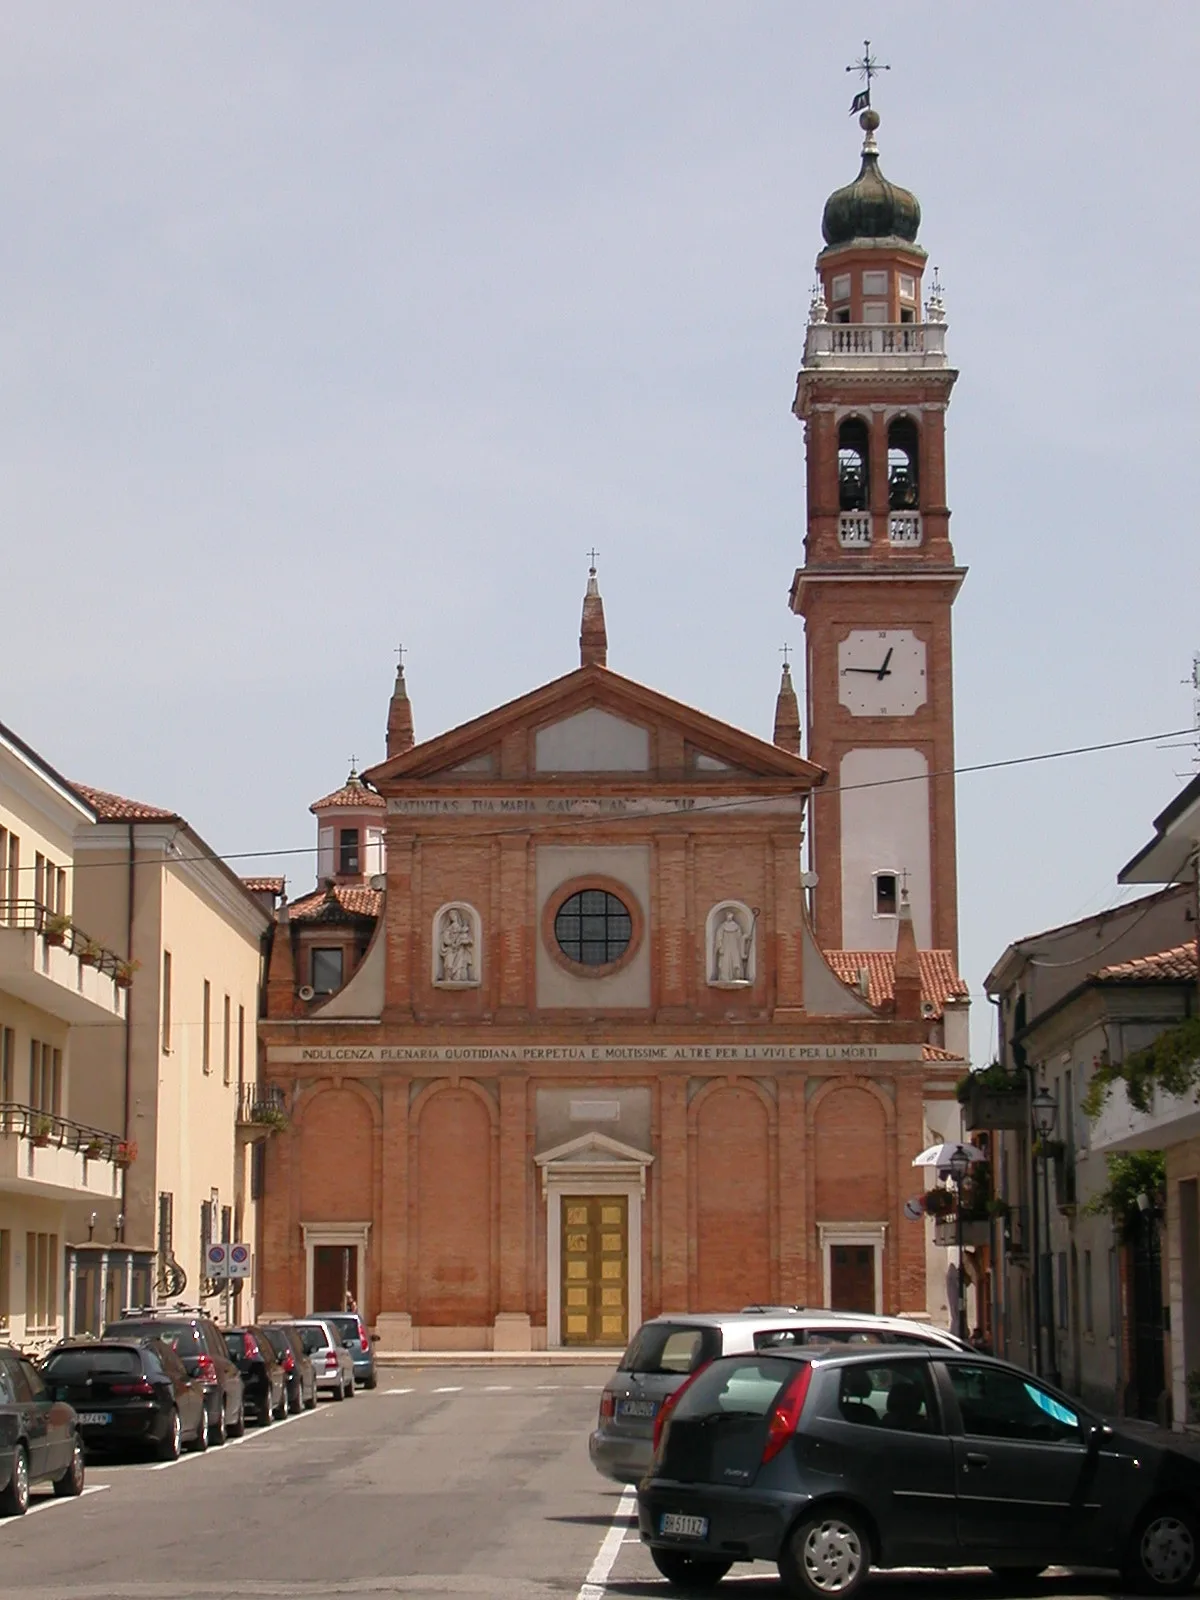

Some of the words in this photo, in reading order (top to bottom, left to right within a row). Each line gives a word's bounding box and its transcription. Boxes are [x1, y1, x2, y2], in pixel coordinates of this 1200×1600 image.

[302, 1049, 374, 1060] INDULGENZA
[381, 1049, 439, 1060] PLENARIA
[445, 1049, 517, 1060] QUOTIDIANA
[524, 1048, 585, 1059] PERPETUA
[592, 1048, 599, 1059] E
[606, 1048, 667, 1059] MOLTISSIME
[675, 1048, 711, 1058] ALTRE
[716, 1048, 738, 1058] PER
[745, 1048, 756, 1058] LI
[762, 1048, 784, 1057] VIVI
[789, 1048, 796, 1057] E
[800, 1048, 820, 1058] PER
[826, 1048, 837, 1058] LI
[842, 1048, 877, 1058] MORTI
